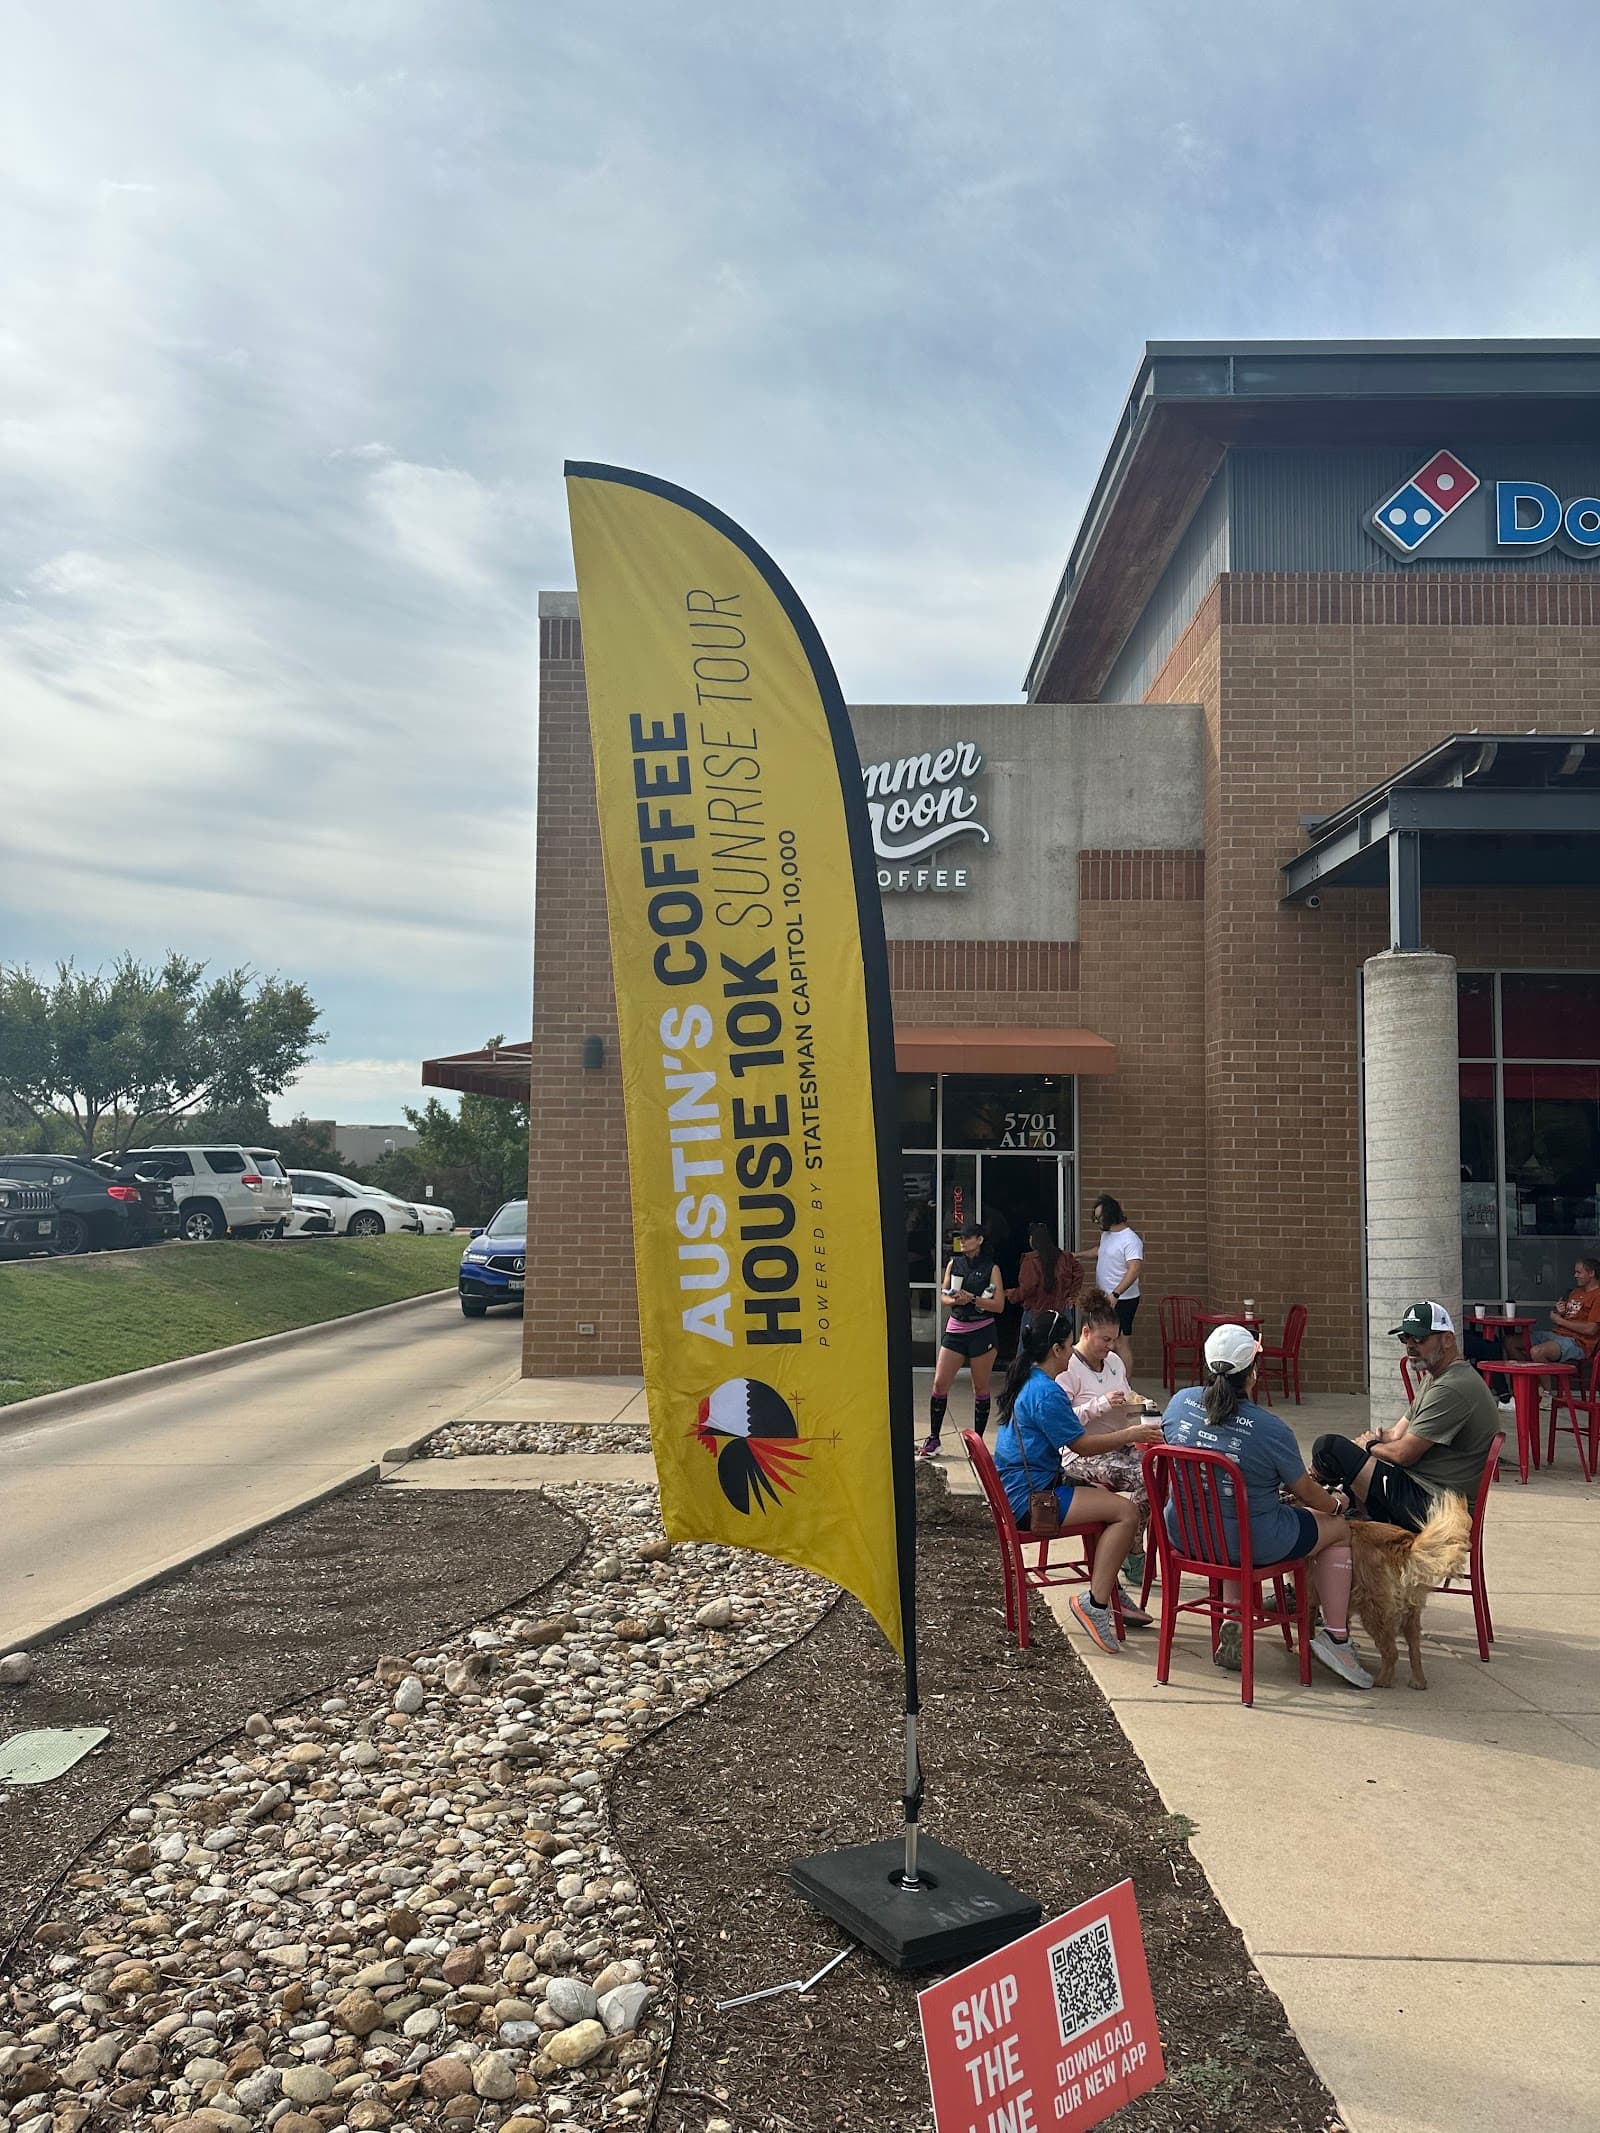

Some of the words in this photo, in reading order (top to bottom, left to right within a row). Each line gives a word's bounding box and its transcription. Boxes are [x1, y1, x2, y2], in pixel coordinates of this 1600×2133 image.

[1496, 480, 1600, 546] Do
[686, 589, 752, 706] TOUR
[629, 712, 707, 986] COFFEE
[700, 721, 773, 928] SUNRISE
[778, 830, 802, 907] 10,000
[786, 913, 811, 1016] CAPITOL
[720, 946, 784, 1078] 10K
[794, 1024, 823, 1169] STATESMAN
[1004, 1113, 1057, 1130] 5701
[660, 1004, 733, 1347] AUSTIN'S
[1000, 1131, 1056, 1148] A170
[731, 1094, 802, 1345] HOUSE
[810, 1182, 823, 1210] BY
[813, 1228, 831, 1347] POWERED
[1235, 1415, 1255, 1428] 10K
[952, 1974, 1018, 2051] SKIP
[965, 2033, 1024, 2106] THE
[1054, 2083, 1083, 2119] OUR
[1084, 2060, 1116, 2100] NEW
[1121, 2041, 1147, 2078] APP
[1056, 2020, 1133, 2087] DOWNLOAD
